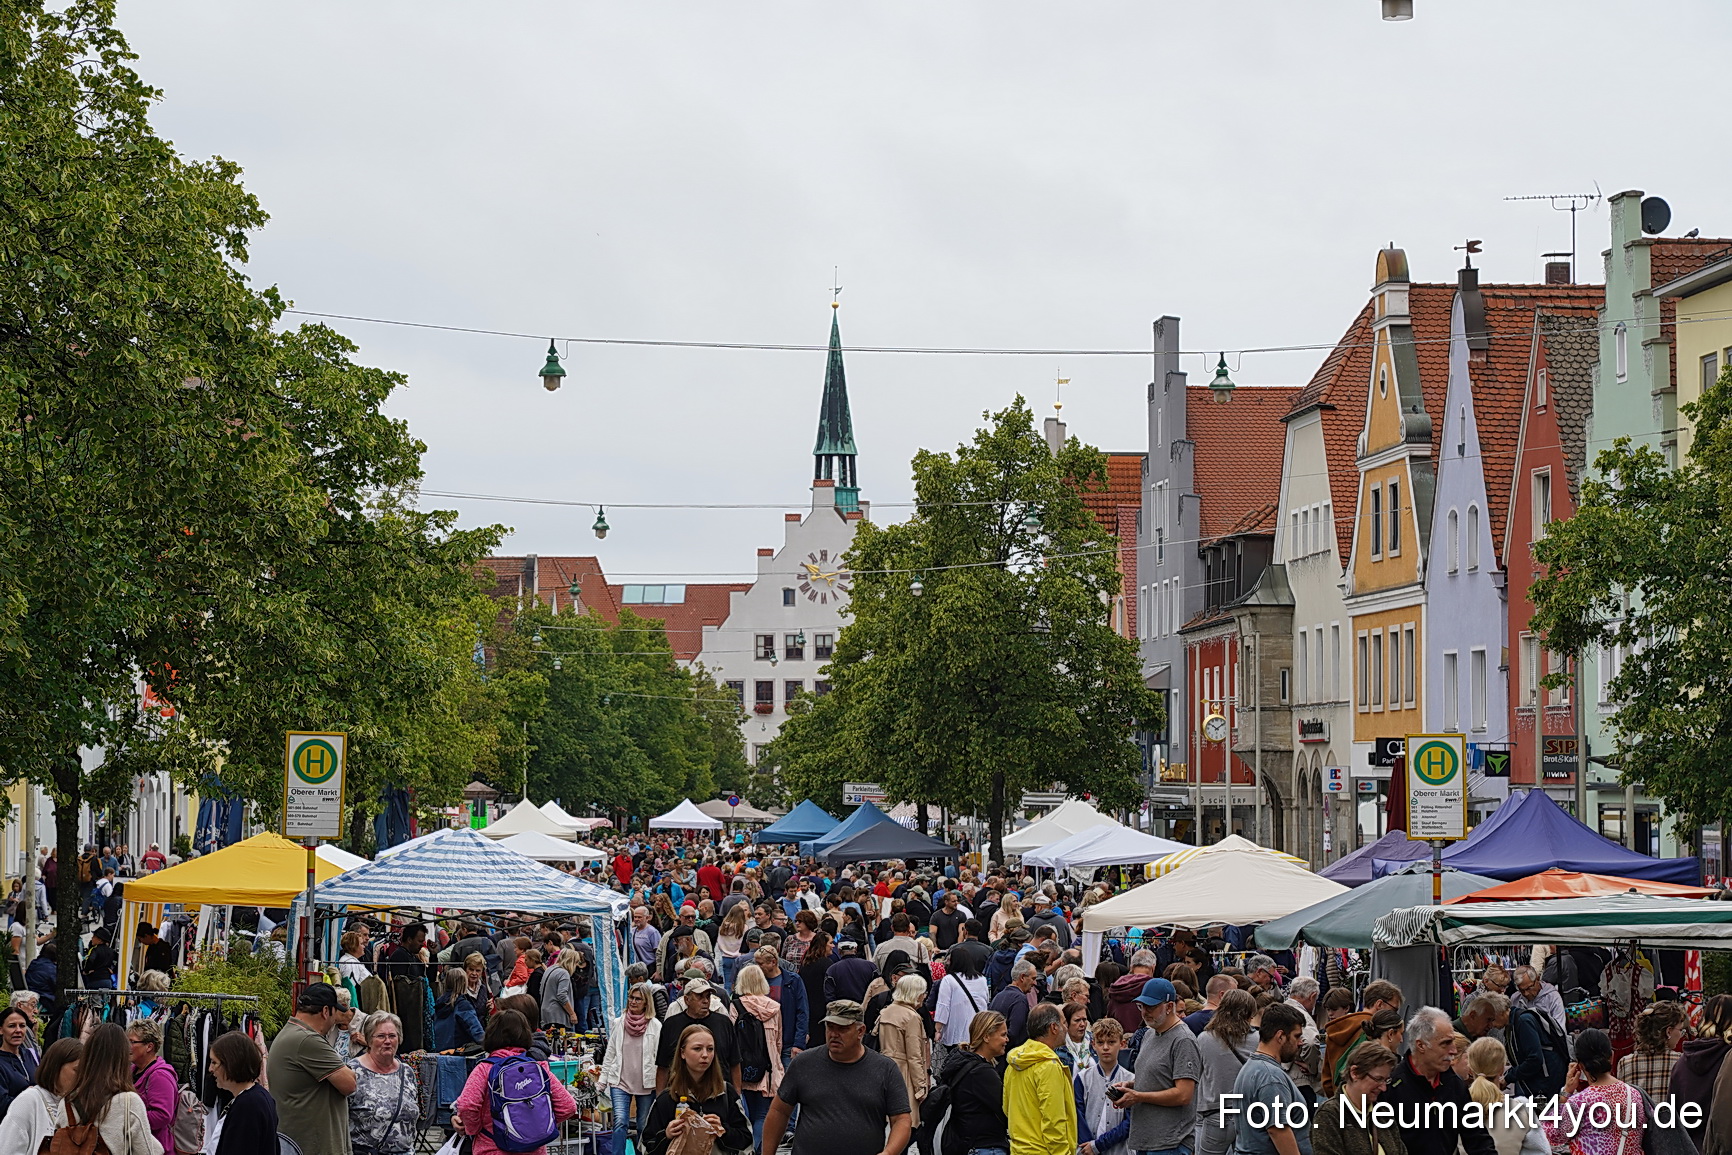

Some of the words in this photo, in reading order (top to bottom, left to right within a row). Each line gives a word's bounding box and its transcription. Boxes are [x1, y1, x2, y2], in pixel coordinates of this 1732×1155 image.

[1543, 755, 1580, 764] Brot&Kaff
[290, 788, 315, 796] Oberer
[515, 1078, 533, 1091] Milka
